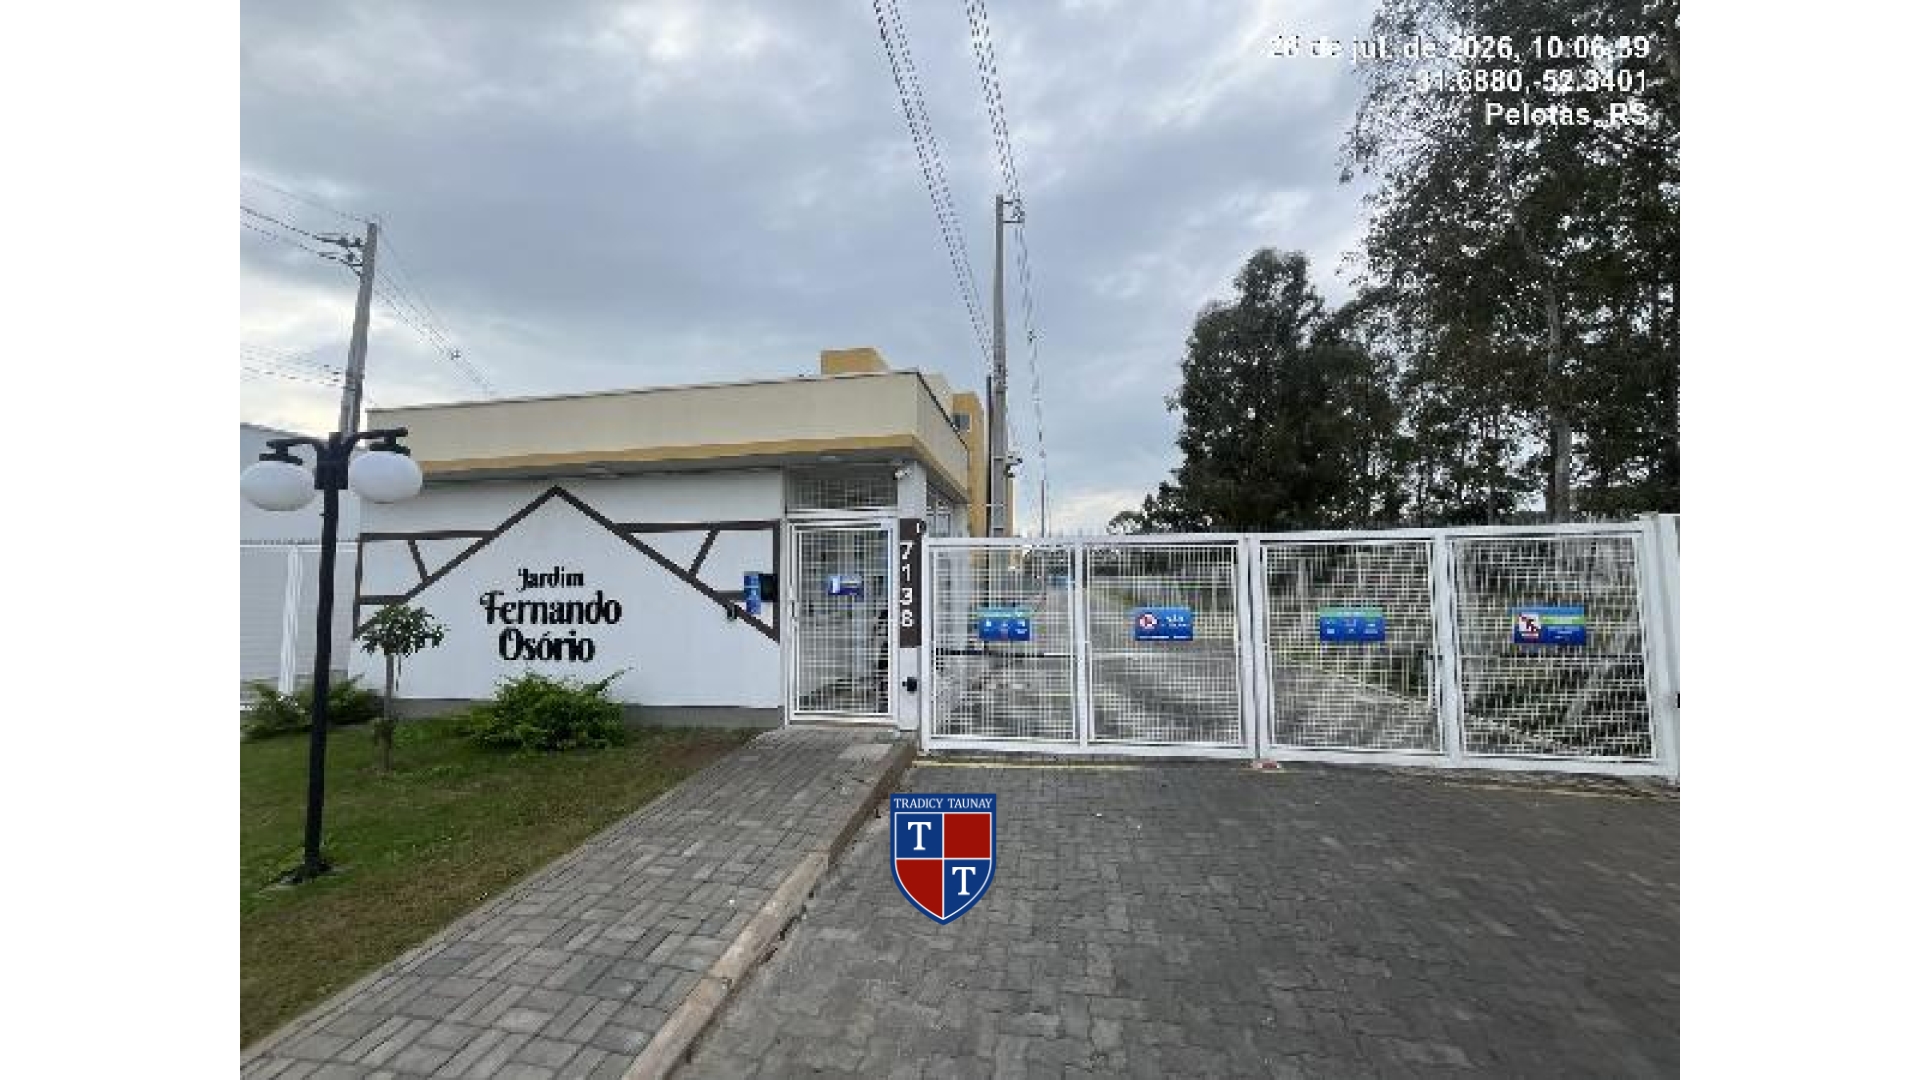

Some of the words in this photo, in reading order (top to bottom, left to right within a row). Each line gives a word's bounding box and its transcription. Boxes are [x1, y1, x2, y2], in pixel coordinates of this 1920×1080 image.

[516, 566, 585, 592] Jardim
[900, 541, 913, 627] 7138
[480, 590, 622, 625] Fernando
[498, 626, 596, 662] Osório
